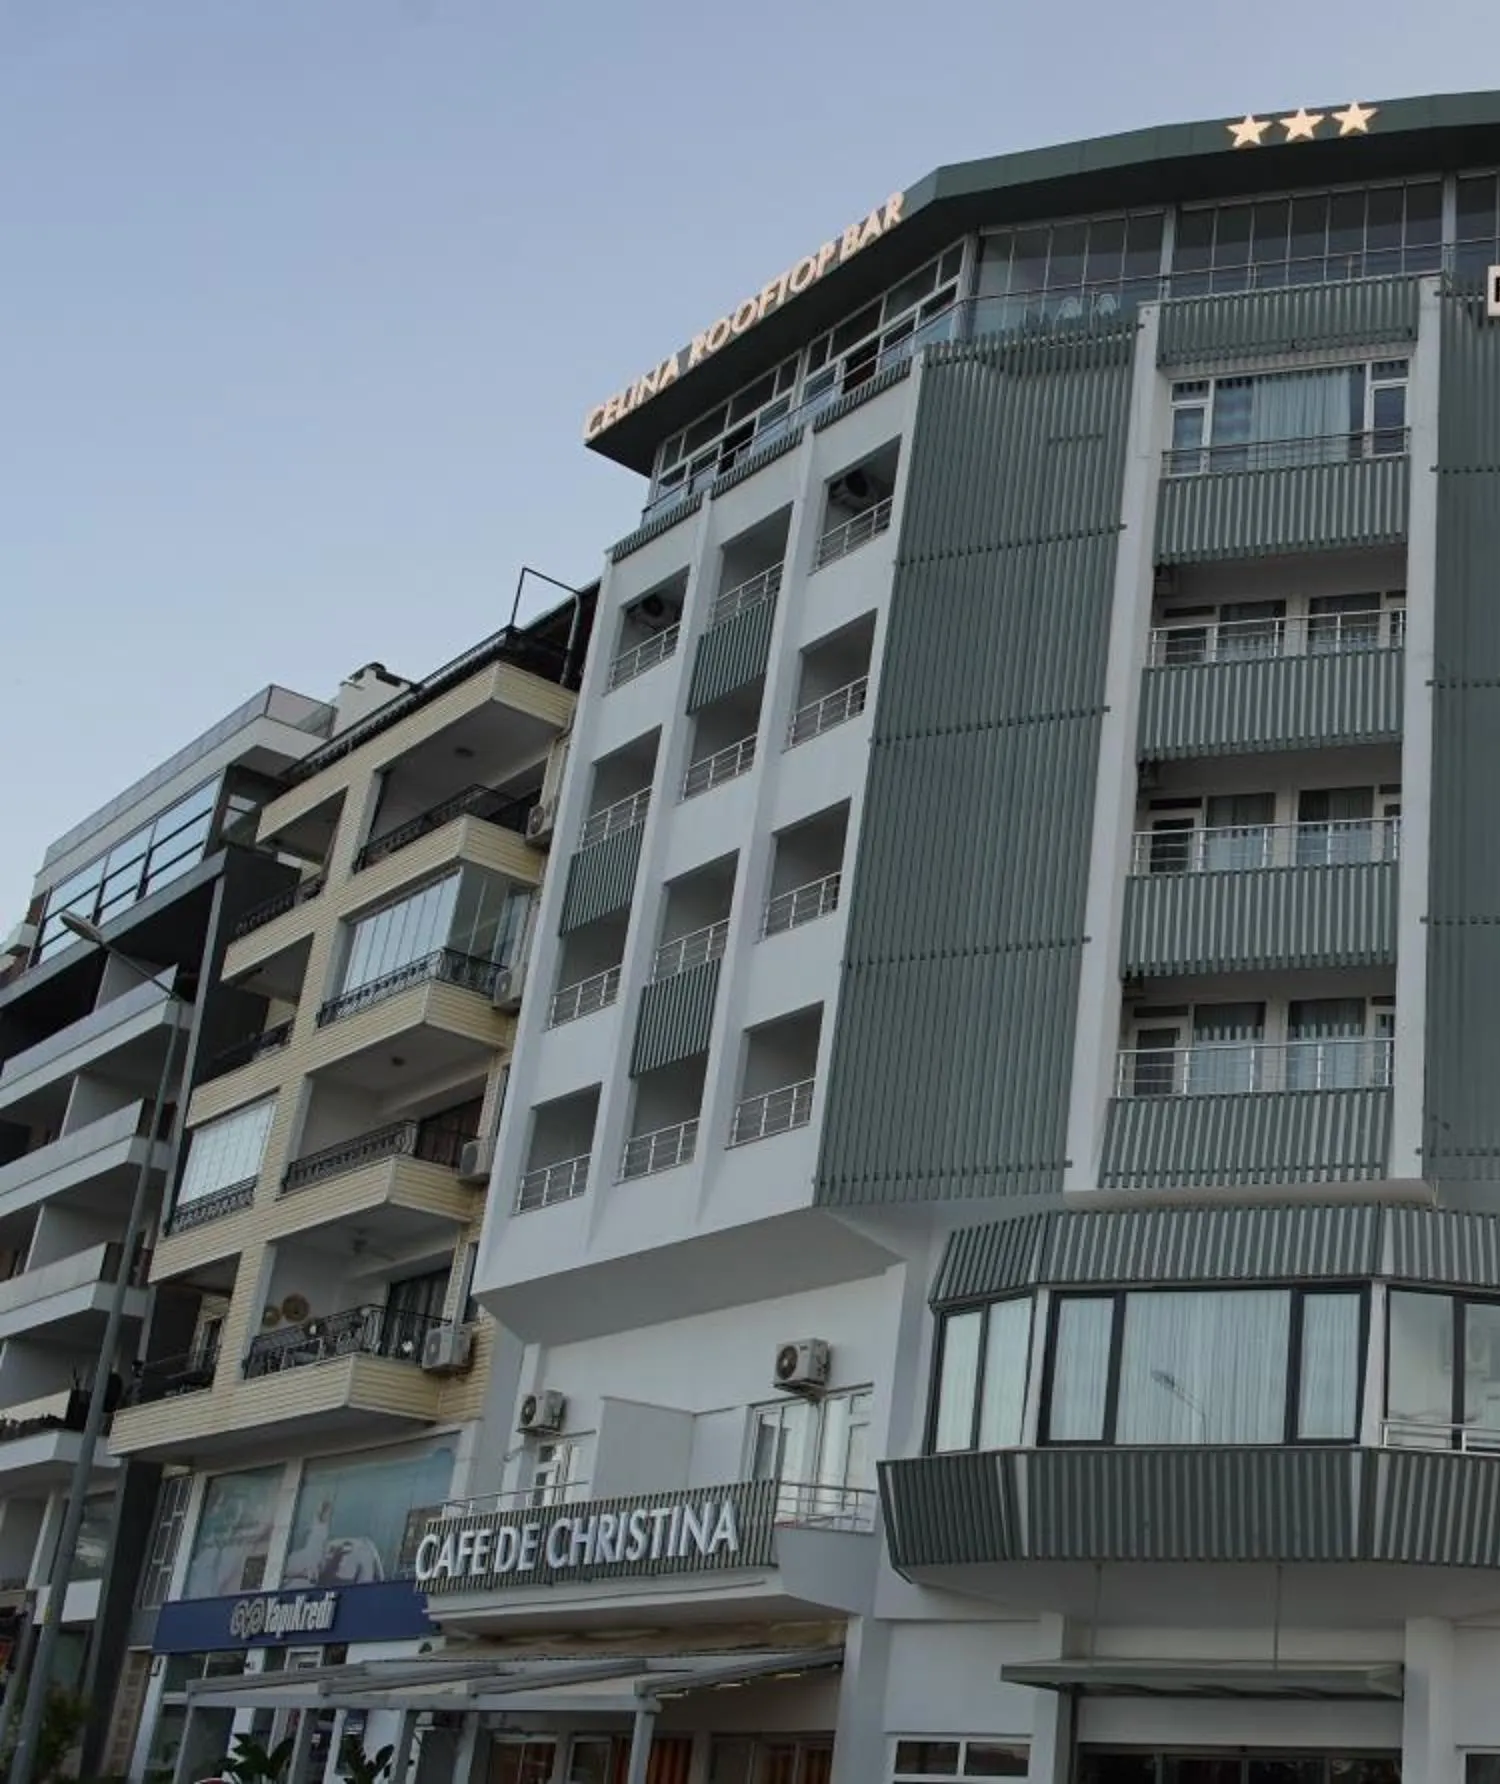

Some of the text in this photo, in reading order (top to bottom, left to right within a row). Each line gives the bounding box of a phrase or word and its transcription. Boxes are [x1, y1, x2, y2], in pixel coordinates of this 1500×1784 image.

[687, 240, 837, 367] ROOFTOP
[839, 192, 904, 261] BAR
[415, 1501, 738, 1580] CAFE DE CHRISTINA
